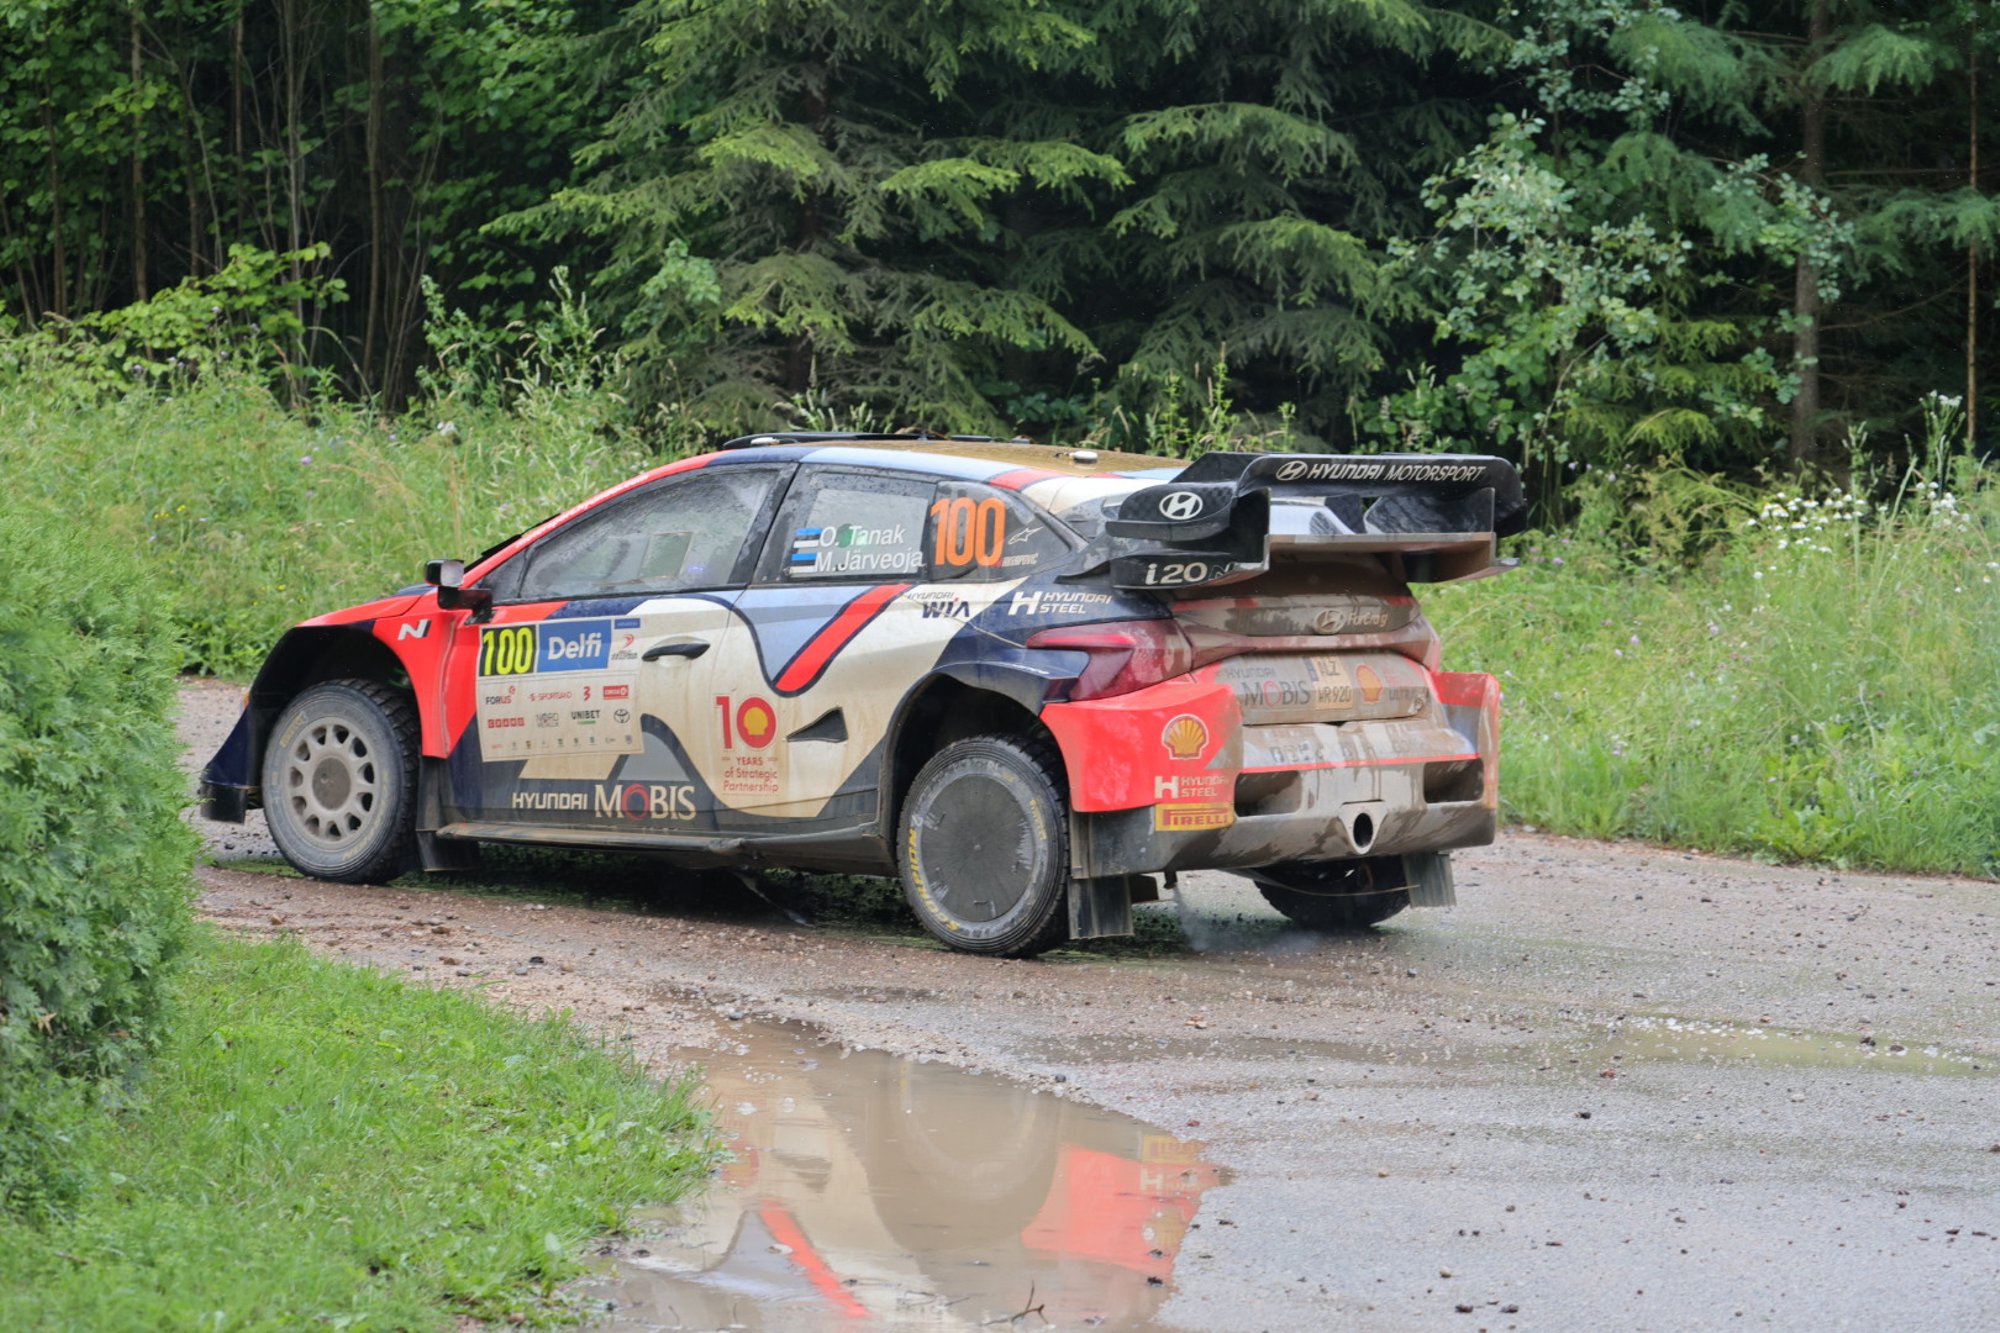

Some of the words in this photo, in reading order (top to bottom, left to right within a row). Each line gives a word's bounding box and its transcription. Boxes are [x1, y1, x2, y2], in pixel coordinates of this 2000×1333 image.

[1307, 464, 1385, 480] HYUNDAI
[1384, 465, 1486, 481] MOTORSPORT
[820, 526, 839, 547] O.
[930, 497, 1006, 566] 100
[1145, 562, 1208, 585] i20
[1043, 591, 1112, 604] HYUNDAI
[922, 598, 970, 618] WIA
[1040, 603, 1086, 614] STEEL
[482, 627, 533, 676] 100
[548, 632, 602, 660] Delfi
[485, 695, 511, 704] FORUS
[1241, 680, 1311, 707] MOBIS
[571, 710, 600, 720] UNIBET
[736, 757, 763, 766] YEARS
[724, 767, 734, 777] of
[736, 768, 777, 781] Strategic
[723, 780, 779, 792] Partnership
[1181, 788, 1217, 797] STEEL
[512, 792, 588, 810] HYUNDAI
[594, 783, 697, 821] MOBIS
[1162, 807, 1229, 826] PIRELLI
